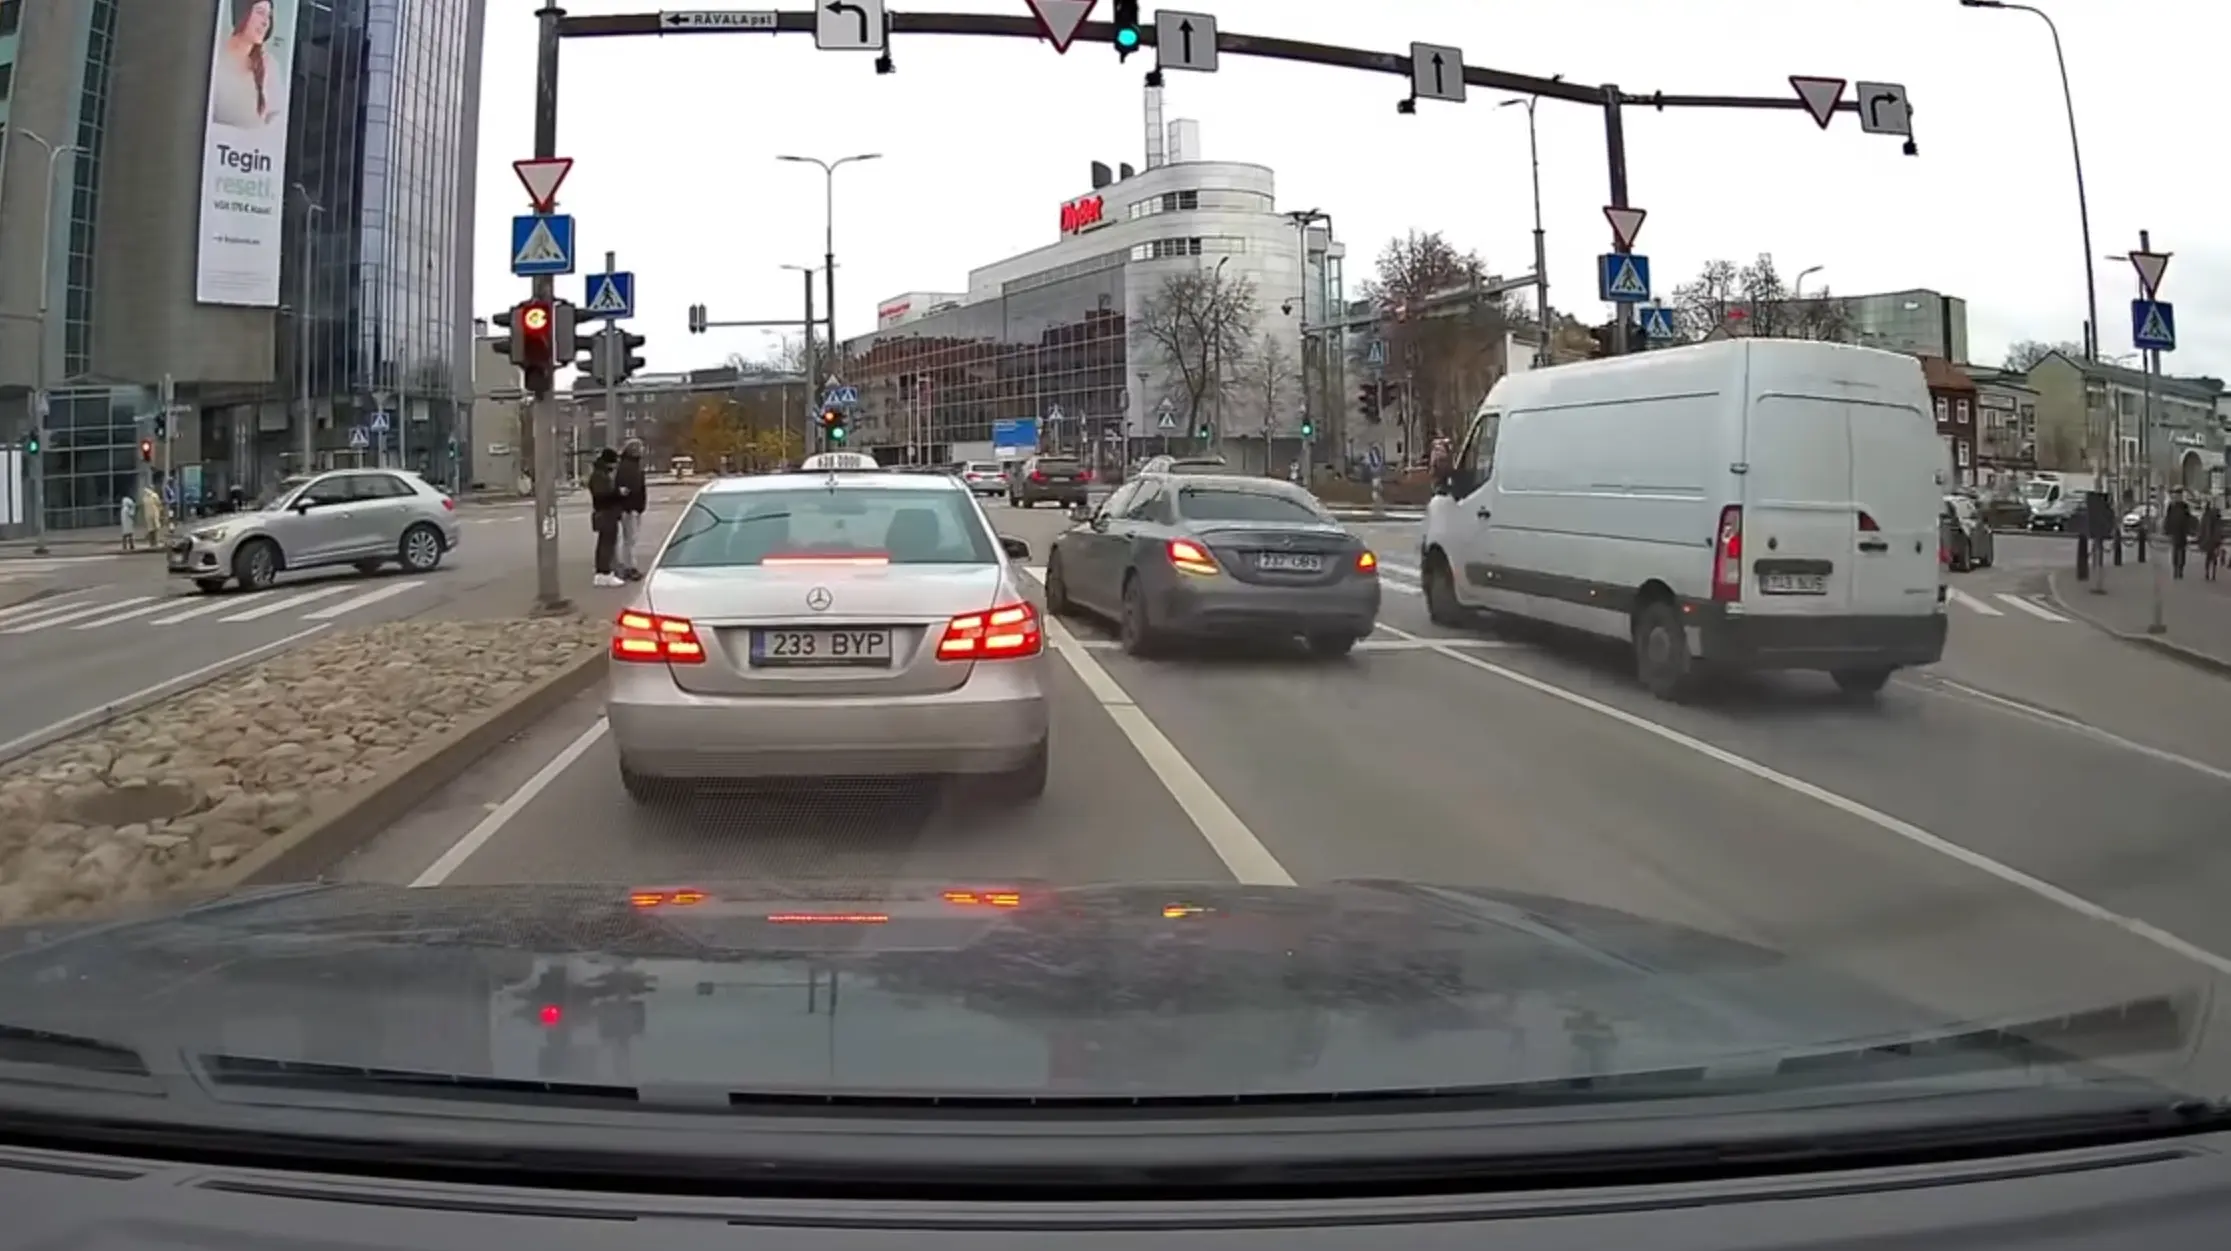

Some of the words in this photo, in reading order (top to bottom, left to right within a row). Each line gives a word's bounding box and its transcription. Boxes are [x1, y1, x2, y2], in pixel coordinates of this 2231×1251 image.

[216, 144, 272, 173] Tegin
[773, 633, 816, 655] 233
[832, 633, 884, 655] BYP
